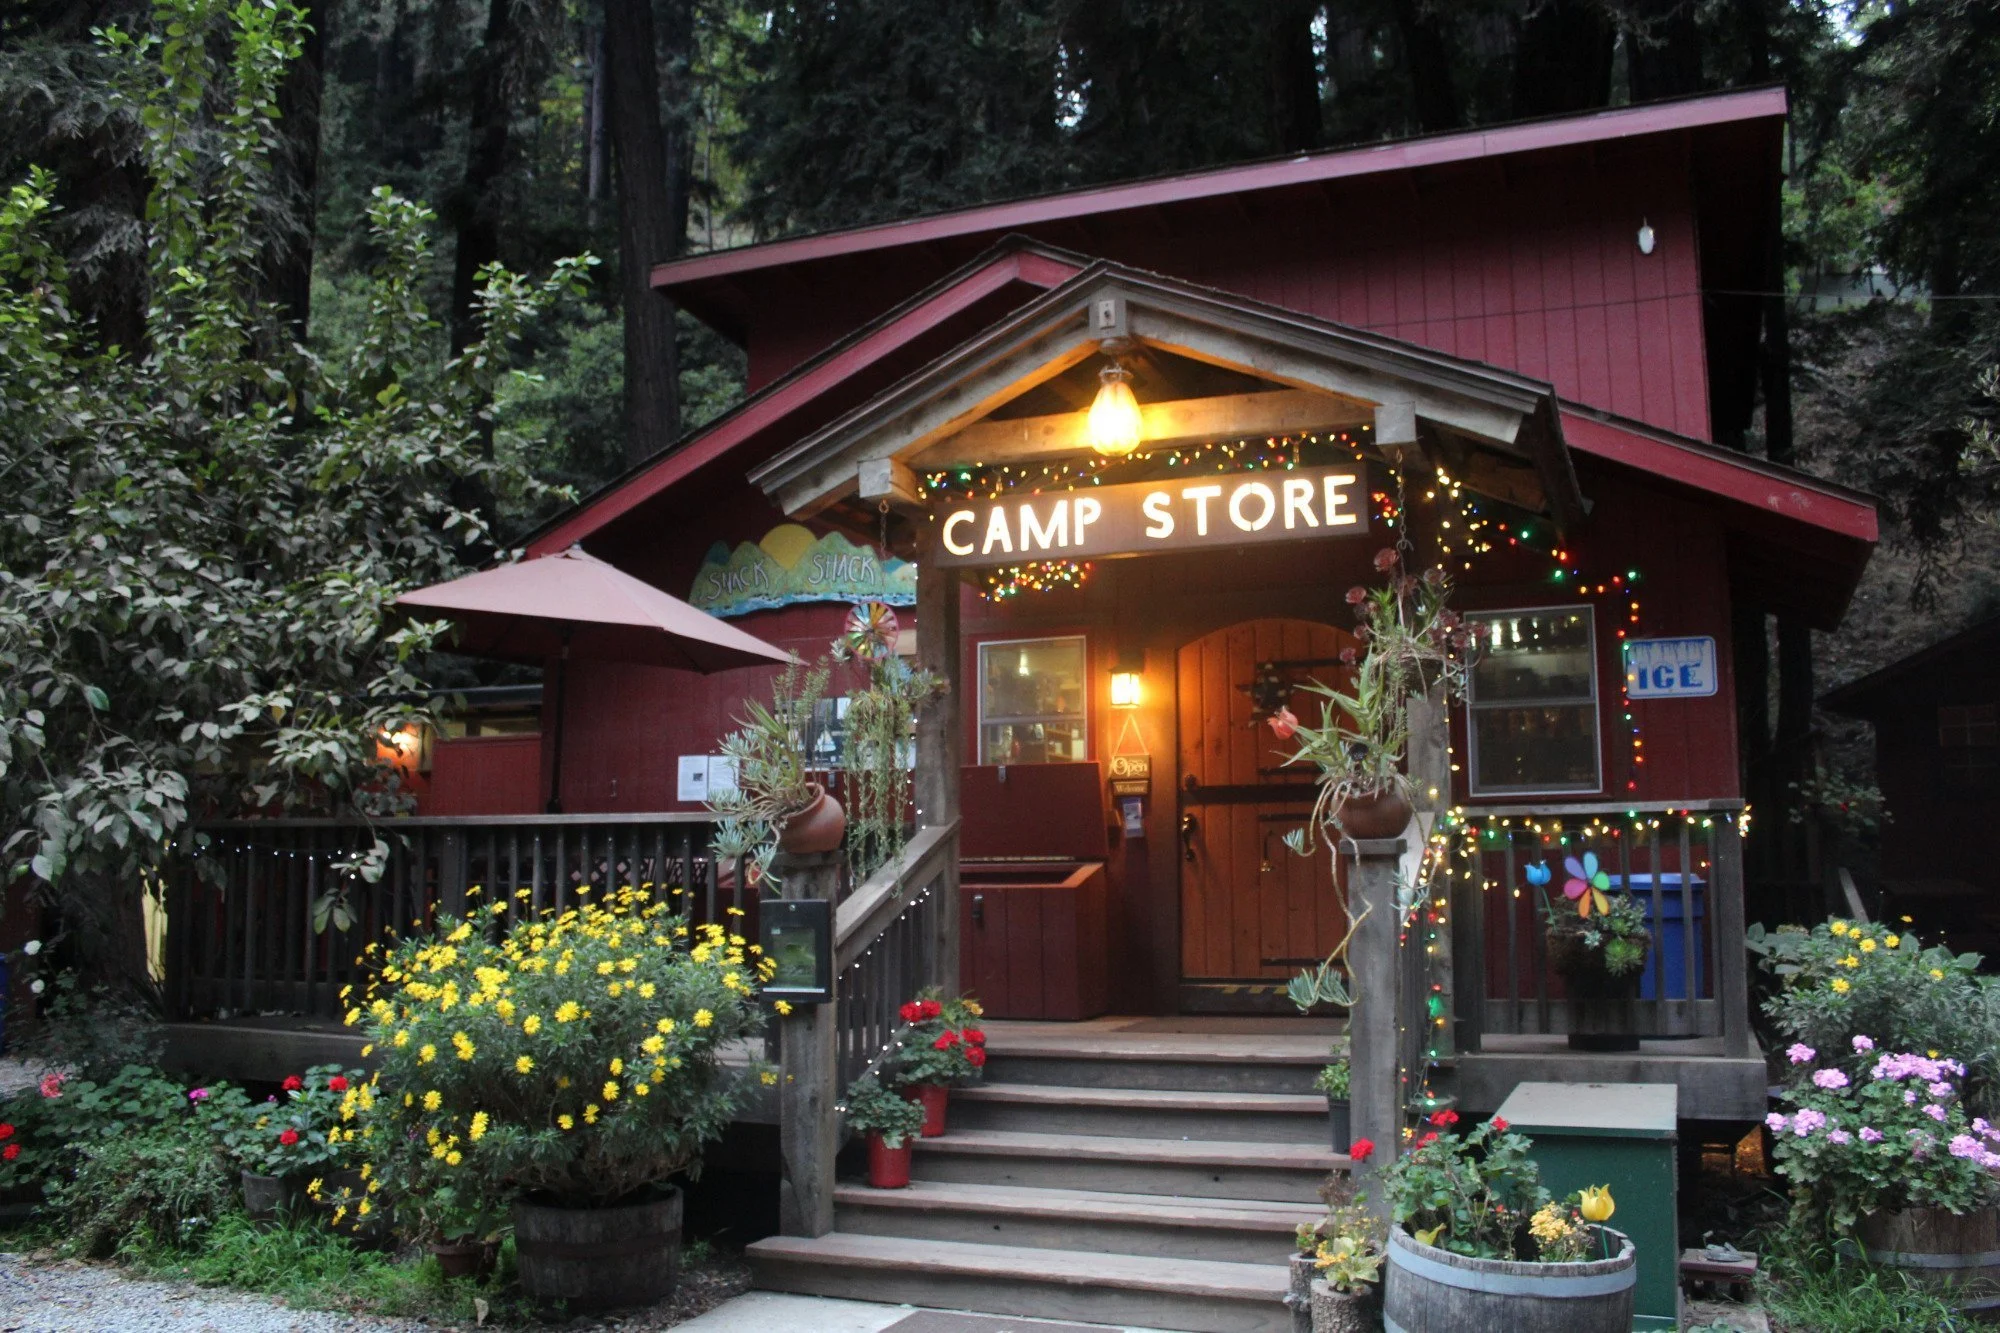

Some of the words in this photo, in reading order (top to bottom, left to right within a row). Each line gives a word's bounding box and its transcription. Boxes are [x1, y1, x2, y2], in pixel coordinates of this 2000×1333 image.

[942, 497, 1102, 556] CAMP
[1142, 474, 1357, 539] STORE
[707, 560, 769, 599] SNACK
[808, 554, 875, 584] SHACK
[1638, 663, 1703, 690] ICE
[1113, 757, 1148, 777] Open
